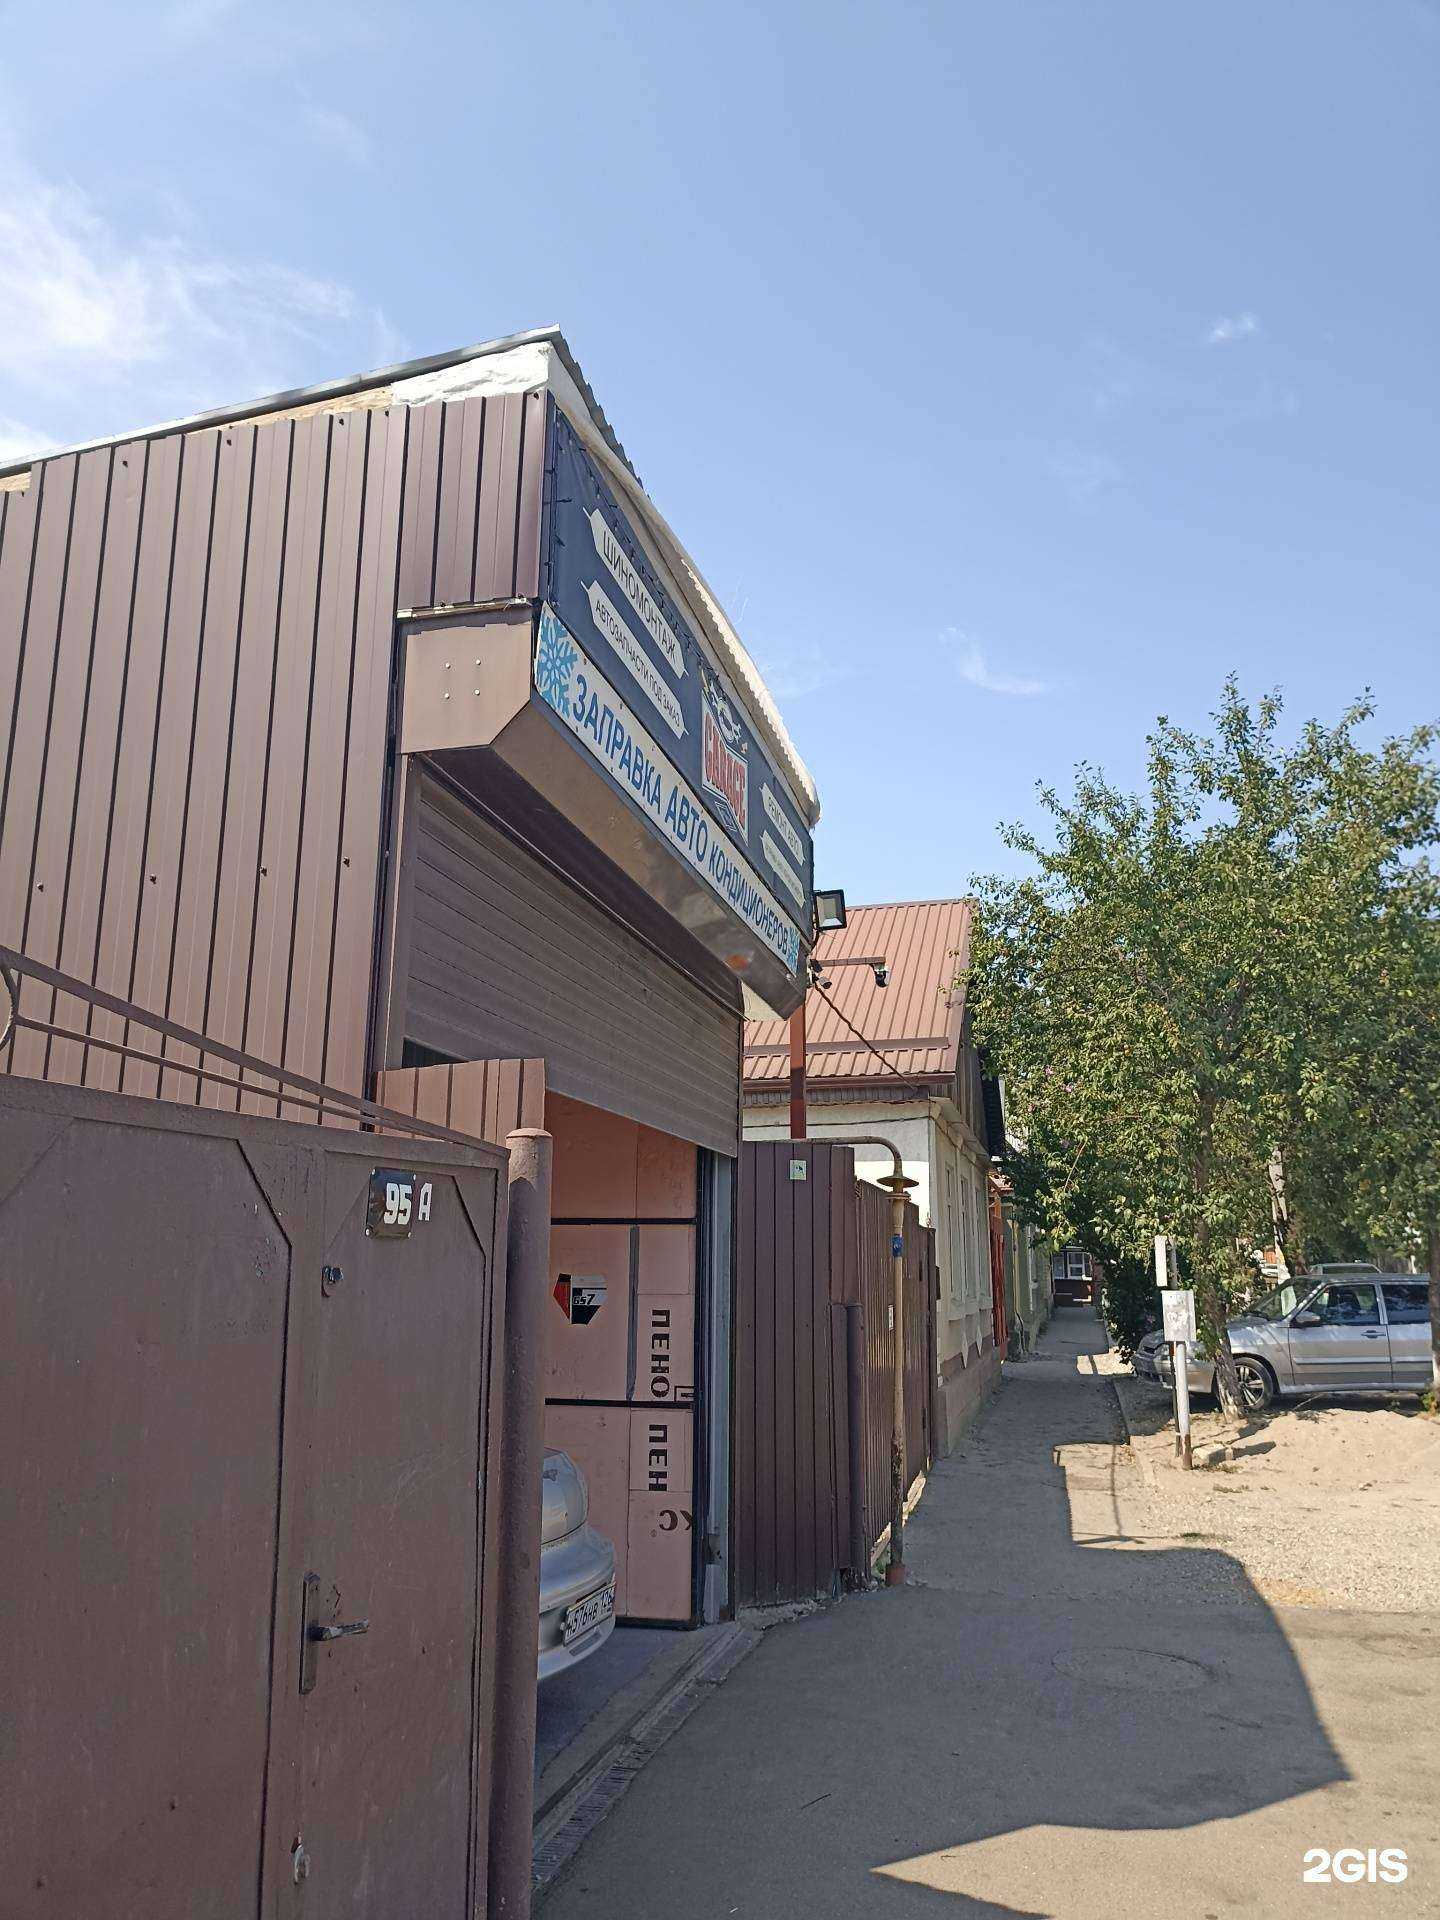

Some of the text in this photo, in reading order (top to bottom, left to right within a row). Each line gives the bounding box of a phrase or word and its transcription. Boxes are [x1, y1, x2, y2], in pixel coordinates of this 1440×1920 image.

[603, 530, 677, 663] ШИНОМОНТАЖ
[595, 600, 650, 686] АВТОЗАПЧАСТИ
[571, 673, 662, 814] ЗАПРАВКА
[664, 785, 708, 862] АВТО
[708, 842, 789, 956] КОНДИЦИОНЕРОВ
[383, 1182, 433, 1225] 95 А
[650, 1309, 671, 1398] ПЕНО
[649, 1424, 668, 1492] ПЕН
